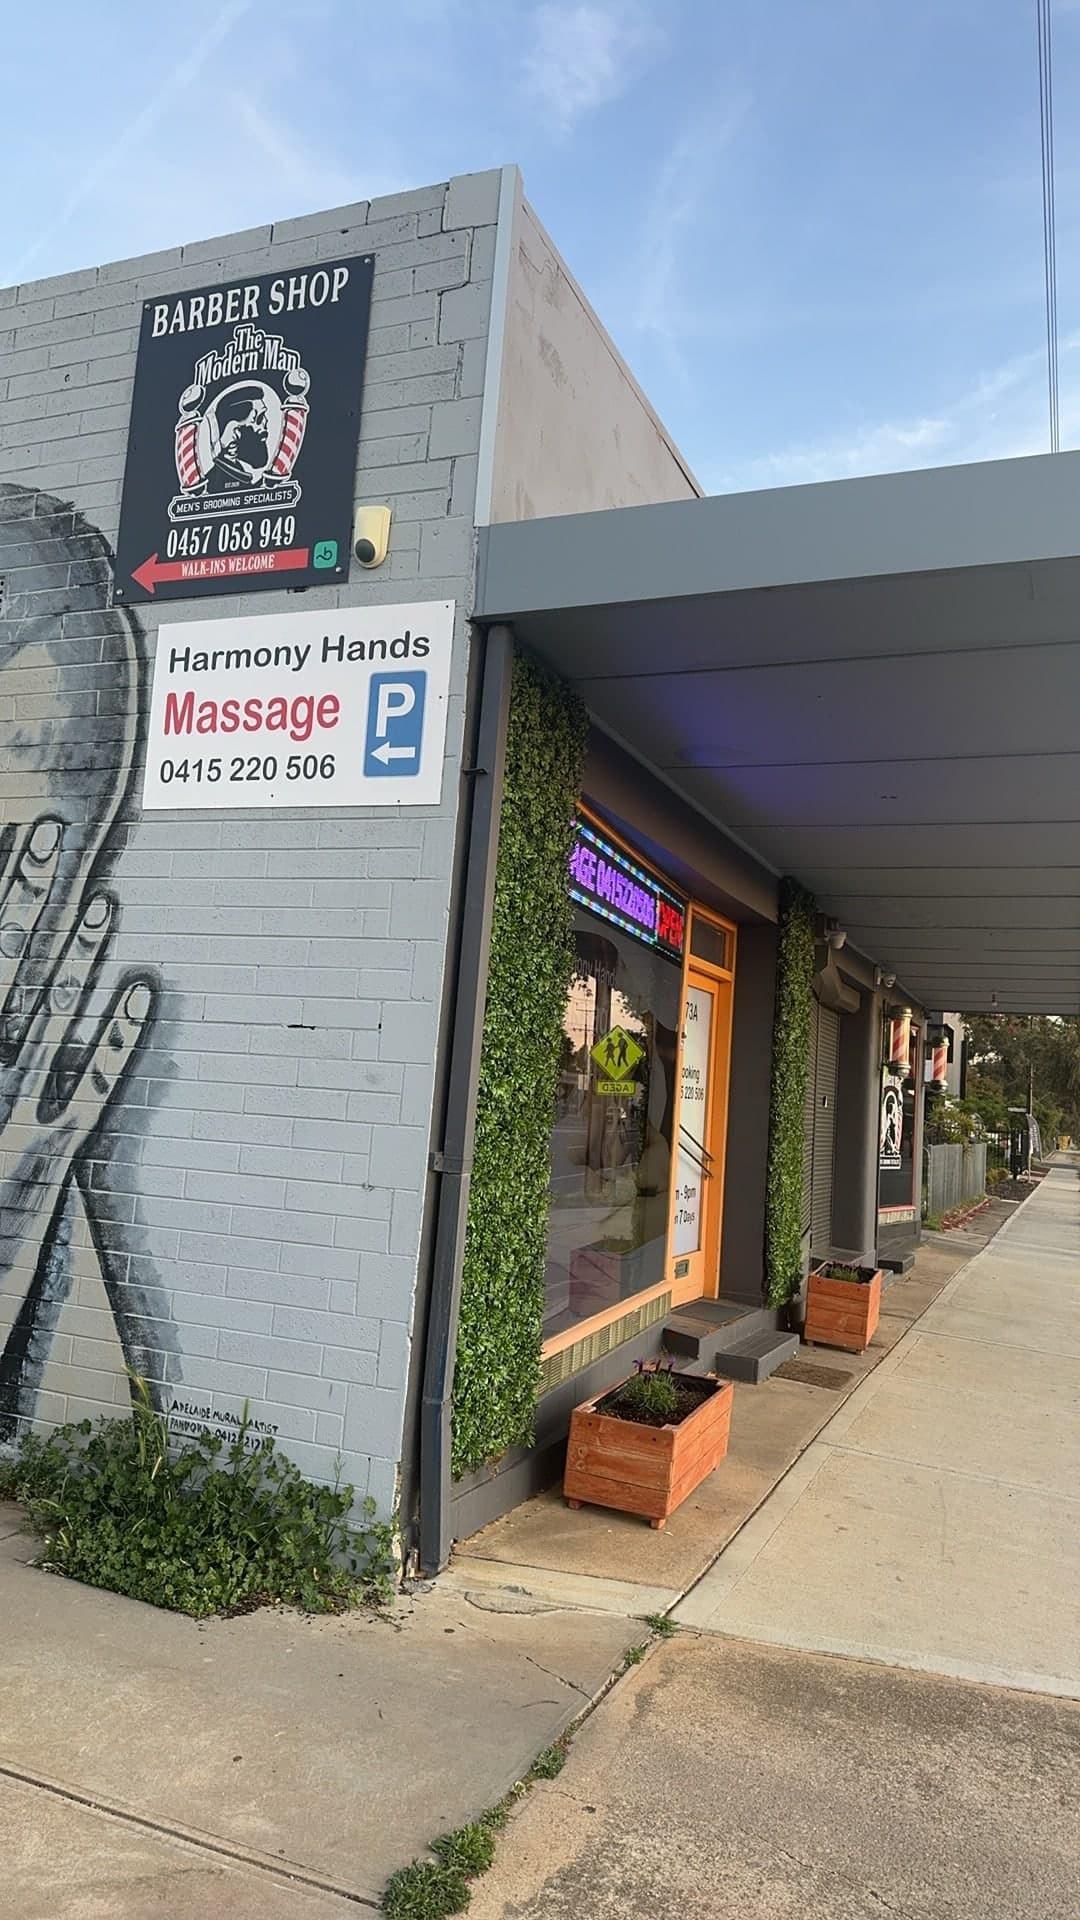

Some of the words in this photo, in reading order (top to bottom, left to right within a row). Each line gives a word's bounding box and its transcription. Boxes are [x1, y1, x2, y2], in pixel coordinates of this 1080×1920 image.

[152, 285, 260, 337] BARBER
[269, 268, 349, 315] SHOP
[237, 327, 263, 352] The
[198, 345, 259, 385] Modern
[262, 339, 297, 371] Man
[176, 502, 200, 513] MEN'S
[203, 496, 241, 510] GROOMING
[243, 490, 293, 505] SPECIALISTS
[167, 526, 213, 558] 0457
[218, 521, 254, 553] 058
[260, 515, 296, 548] 949
[181, 559, 227, 577] WALK-INS
[228, 554, 275, 573] WELCOME
[169, 643, 312, 674] Harmony
[321, 630, 431, 664] Hands
[163, 690, 341, 742] Massage
[375, 683, 416, 738] P
[160, 758, 222, 784] 0415
[229, 756, 278, 782] 220
[285, 753, 336, 780] 506
[686, 1001, 698, 1022] 73A
[681, 1065, 700, 1084] ooking
[684, 1086, 694, 1100] 220
[695, 1087, 704, 1101] 506
[684, 1210, 695, 1224] Days
[171, 1400, 211, 1418] ADELAIDE
[213, 1410, 243, 1426] MURAL
[247, 1419, 279, 1434] ARTIST
